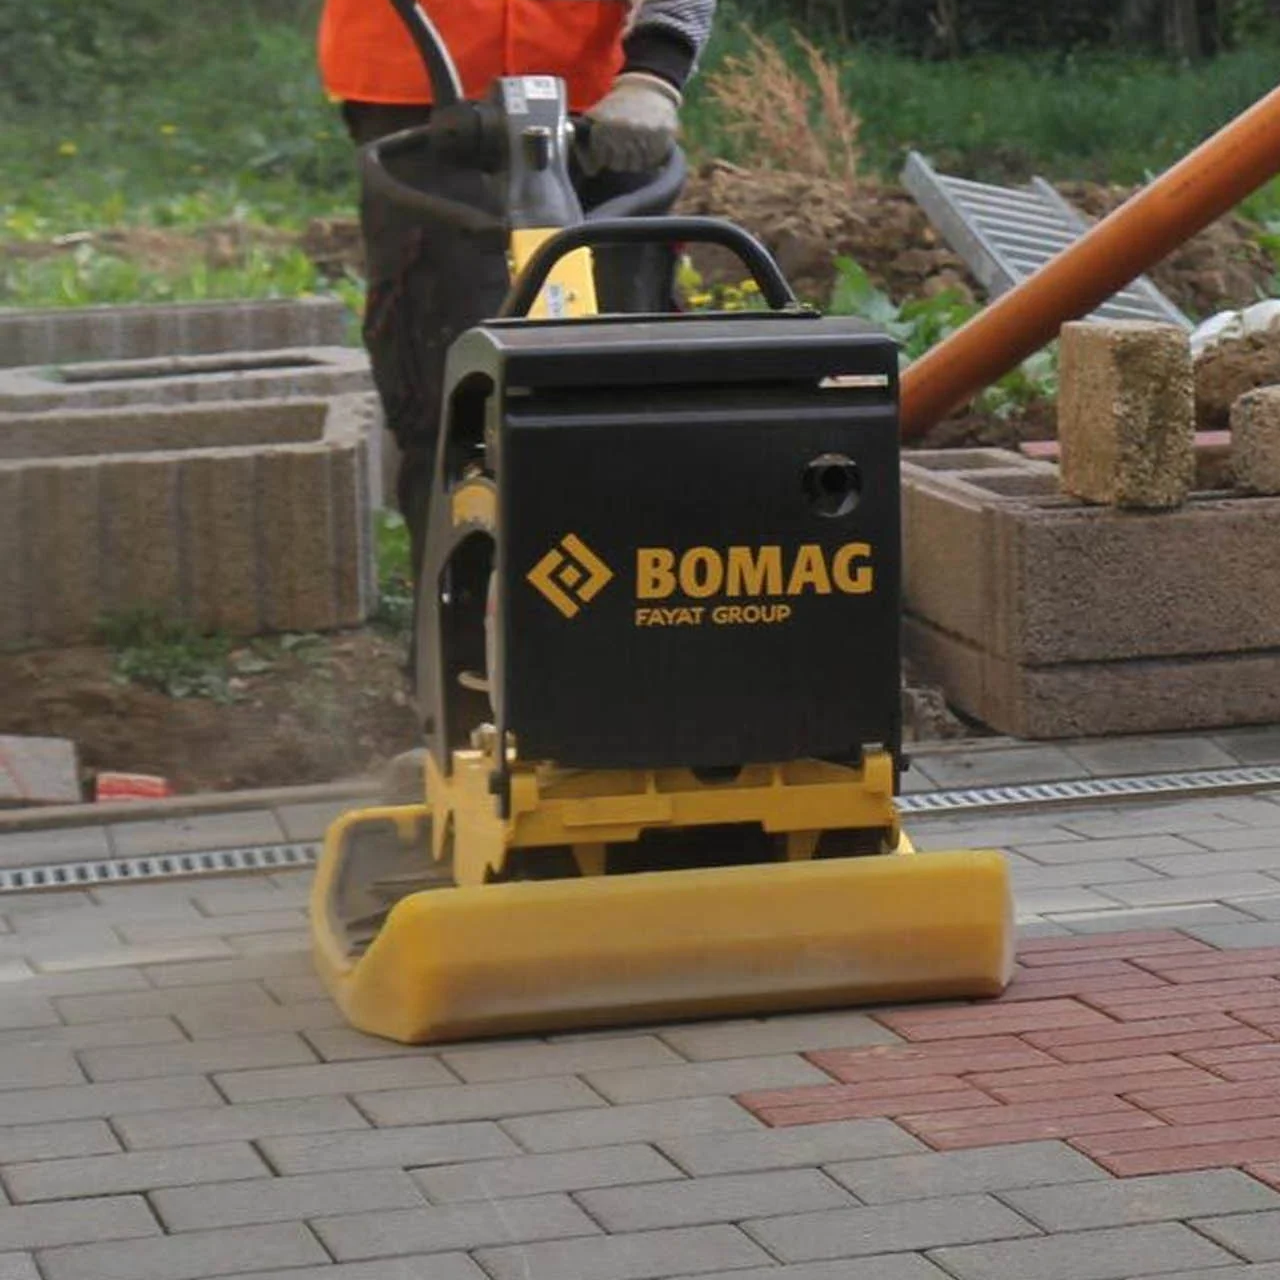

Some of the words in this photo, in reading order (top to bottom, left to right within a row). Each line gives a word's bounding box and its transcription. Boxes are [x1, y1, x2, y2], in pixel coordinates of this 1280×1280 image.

[636, 542, 874, 599] BOMAG
[635, 607, 705, 626] FAYAT
[711, 604, 792, 625] GROUP
